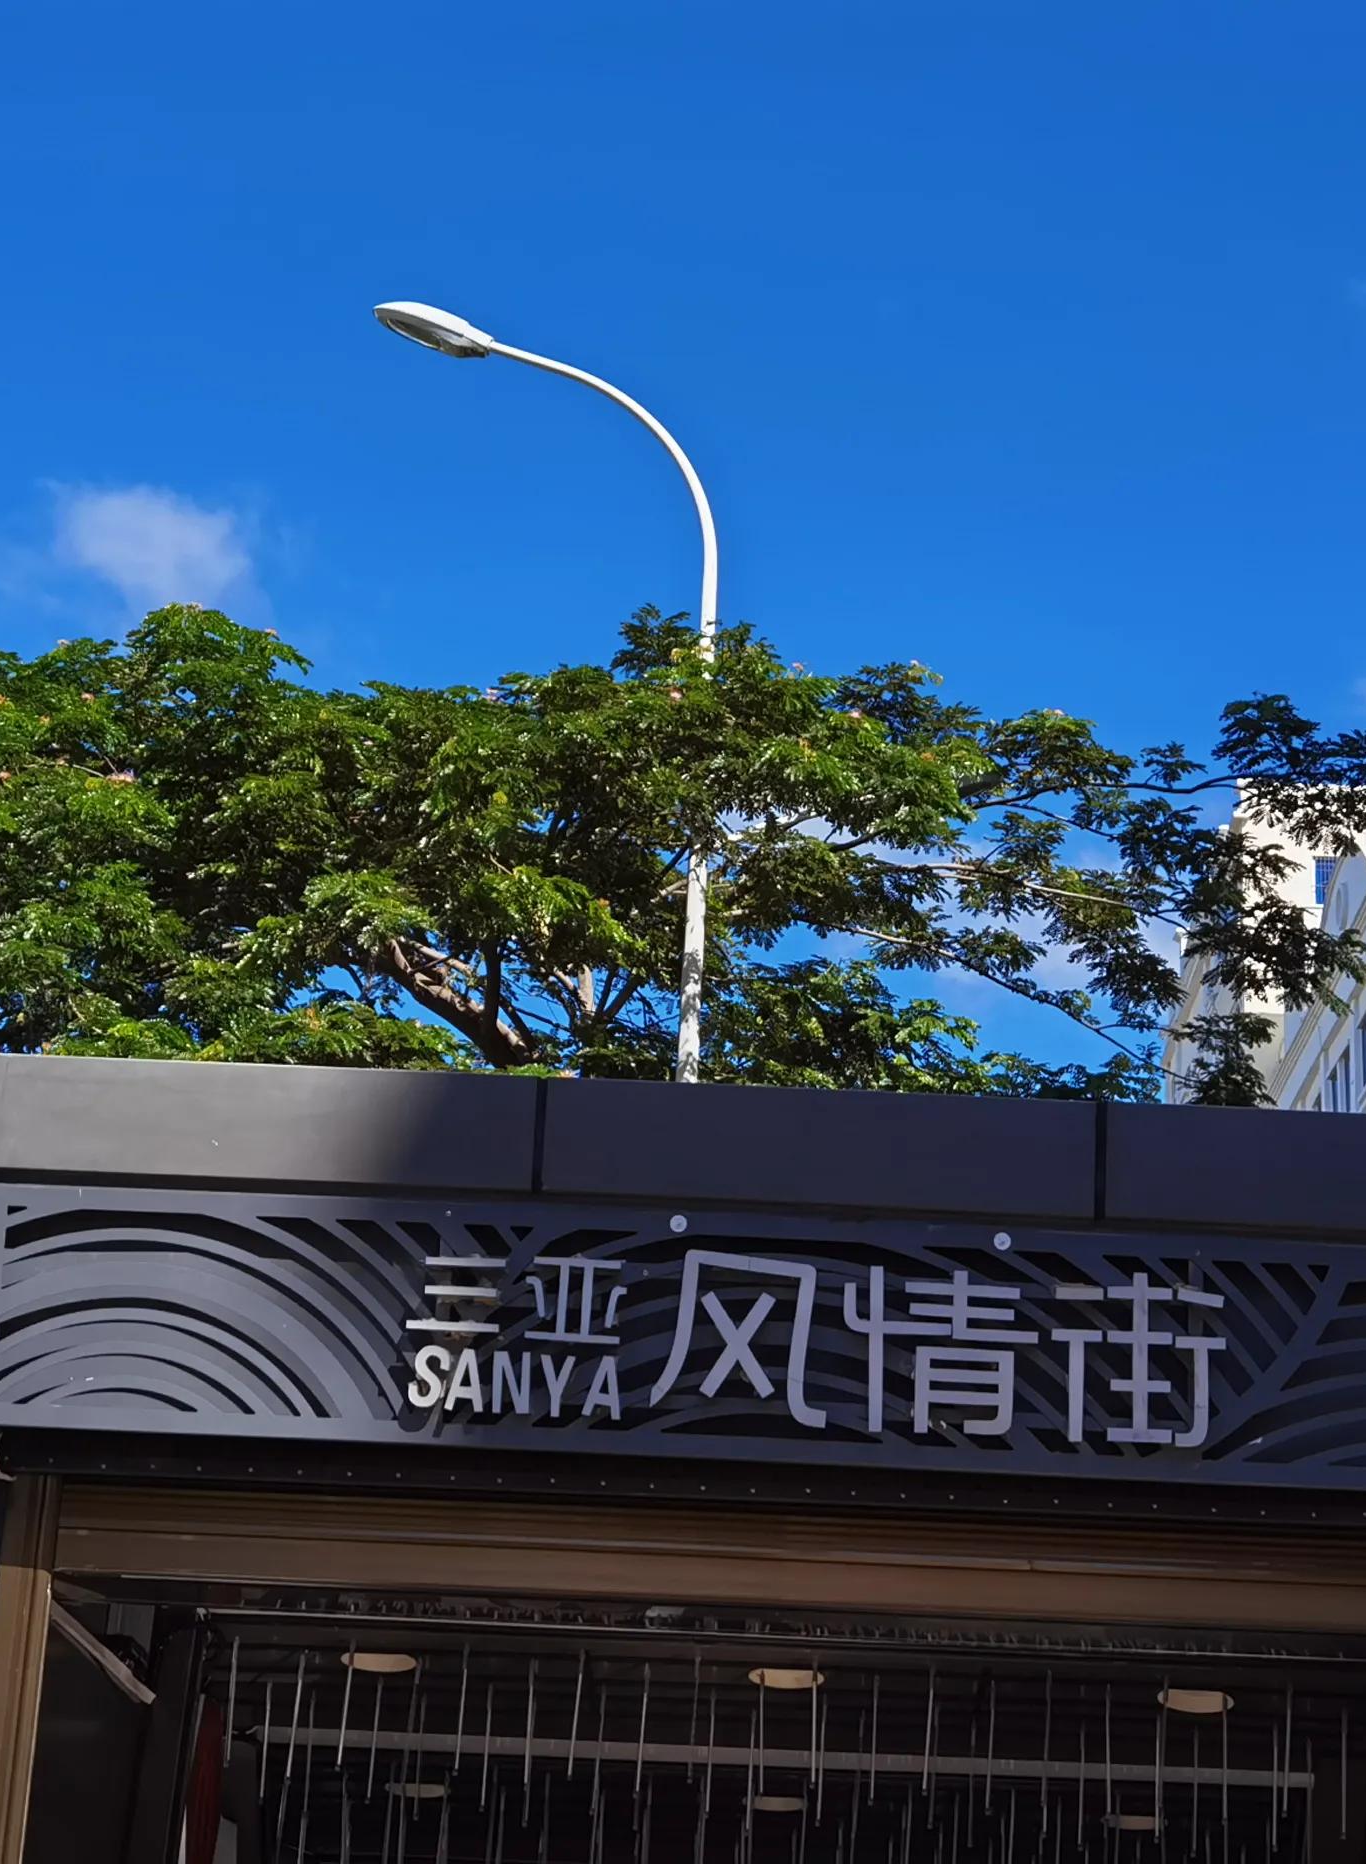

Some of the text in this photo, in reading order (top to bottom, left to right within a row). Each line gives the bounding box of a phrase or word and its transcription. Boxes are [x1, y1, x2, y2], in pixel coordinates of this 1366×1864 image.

[407, 1249, 1226, 1448] 三亚 风情街
[407, 1344, 622, 1420] SANYA
